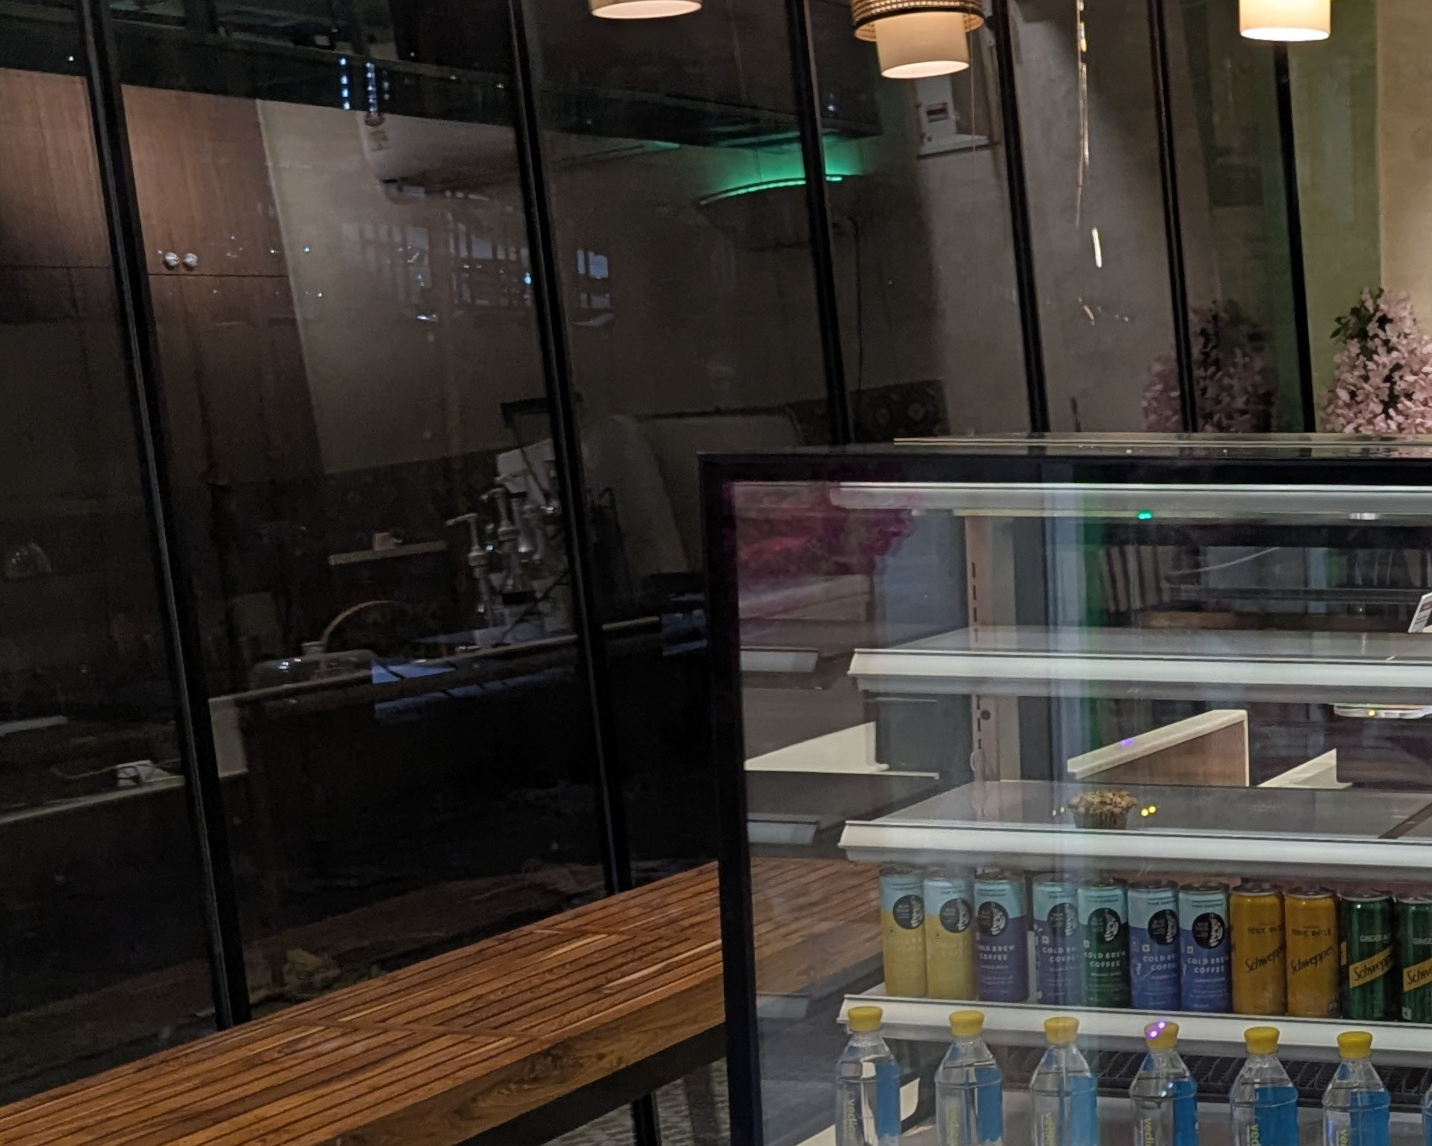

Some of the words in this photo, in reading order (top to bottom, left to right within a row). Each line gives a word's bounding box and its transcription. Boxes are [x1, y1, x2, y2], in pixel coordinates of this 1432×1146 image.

[1090, 960, 1120, 968] COFFEE
[1187, 957, 1209, 965] COLD
[1193, 965, 1225, 974] COFFEE
[1143, 1117, 1154, 1146] vedi
[1251, 1123, 1262, 1146] ved
